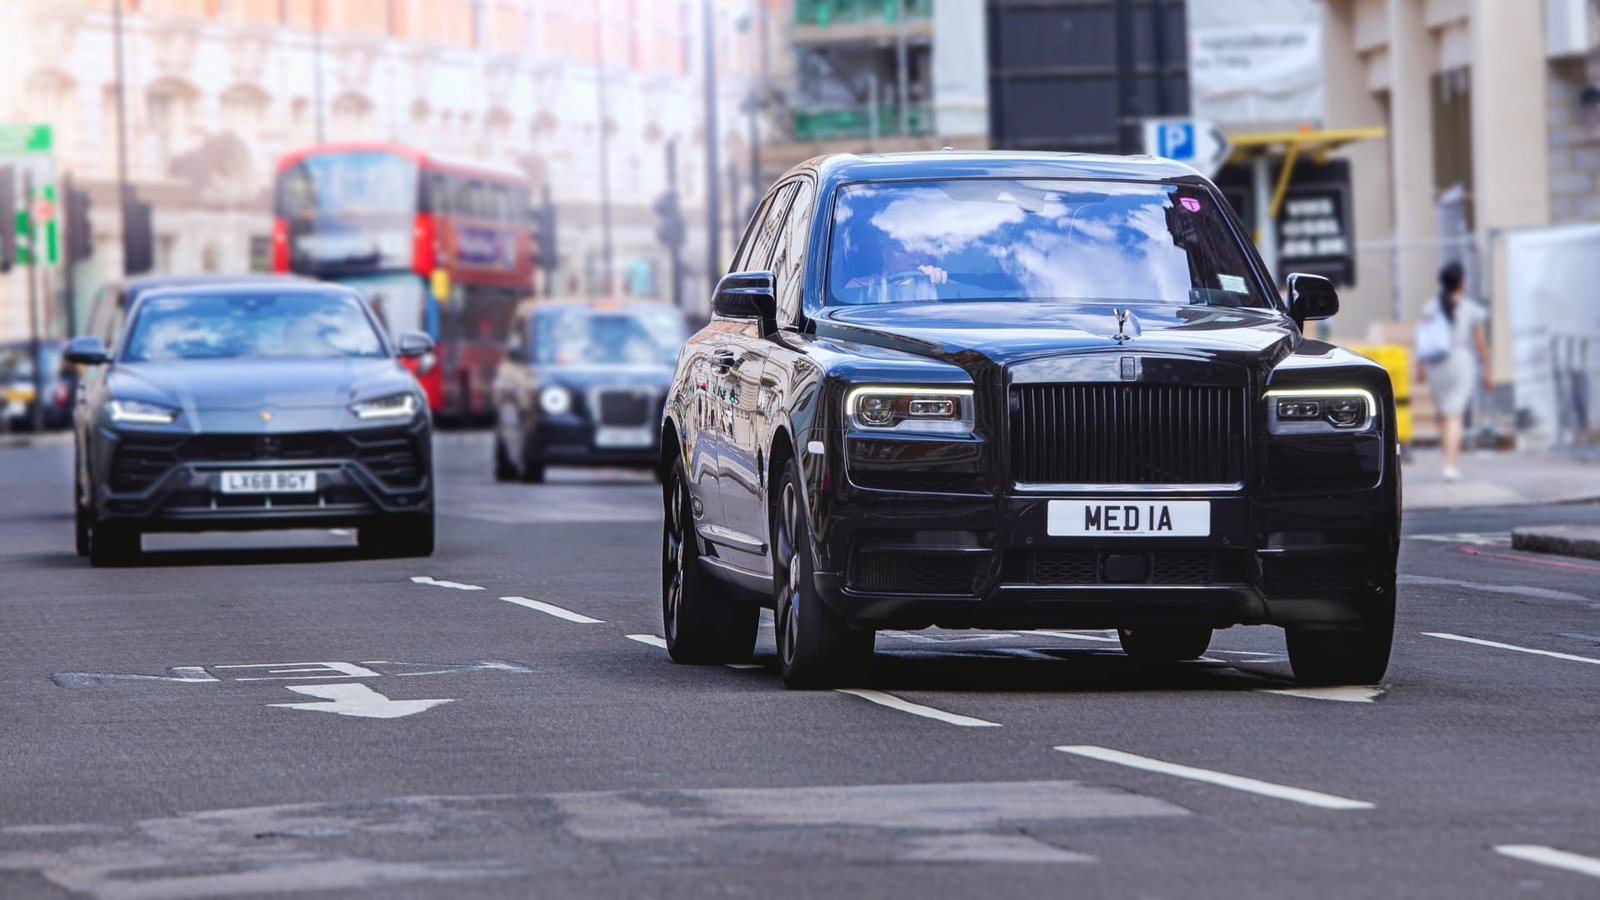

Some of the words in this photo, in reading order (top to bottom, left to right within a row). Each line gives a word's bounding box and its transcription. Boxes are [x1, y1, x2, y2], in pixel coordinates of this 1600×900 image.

[1165, 124, 1187, 158] P
[277, 472, 308, 489] BGY
[1084, 505, 1139, 531] MED
